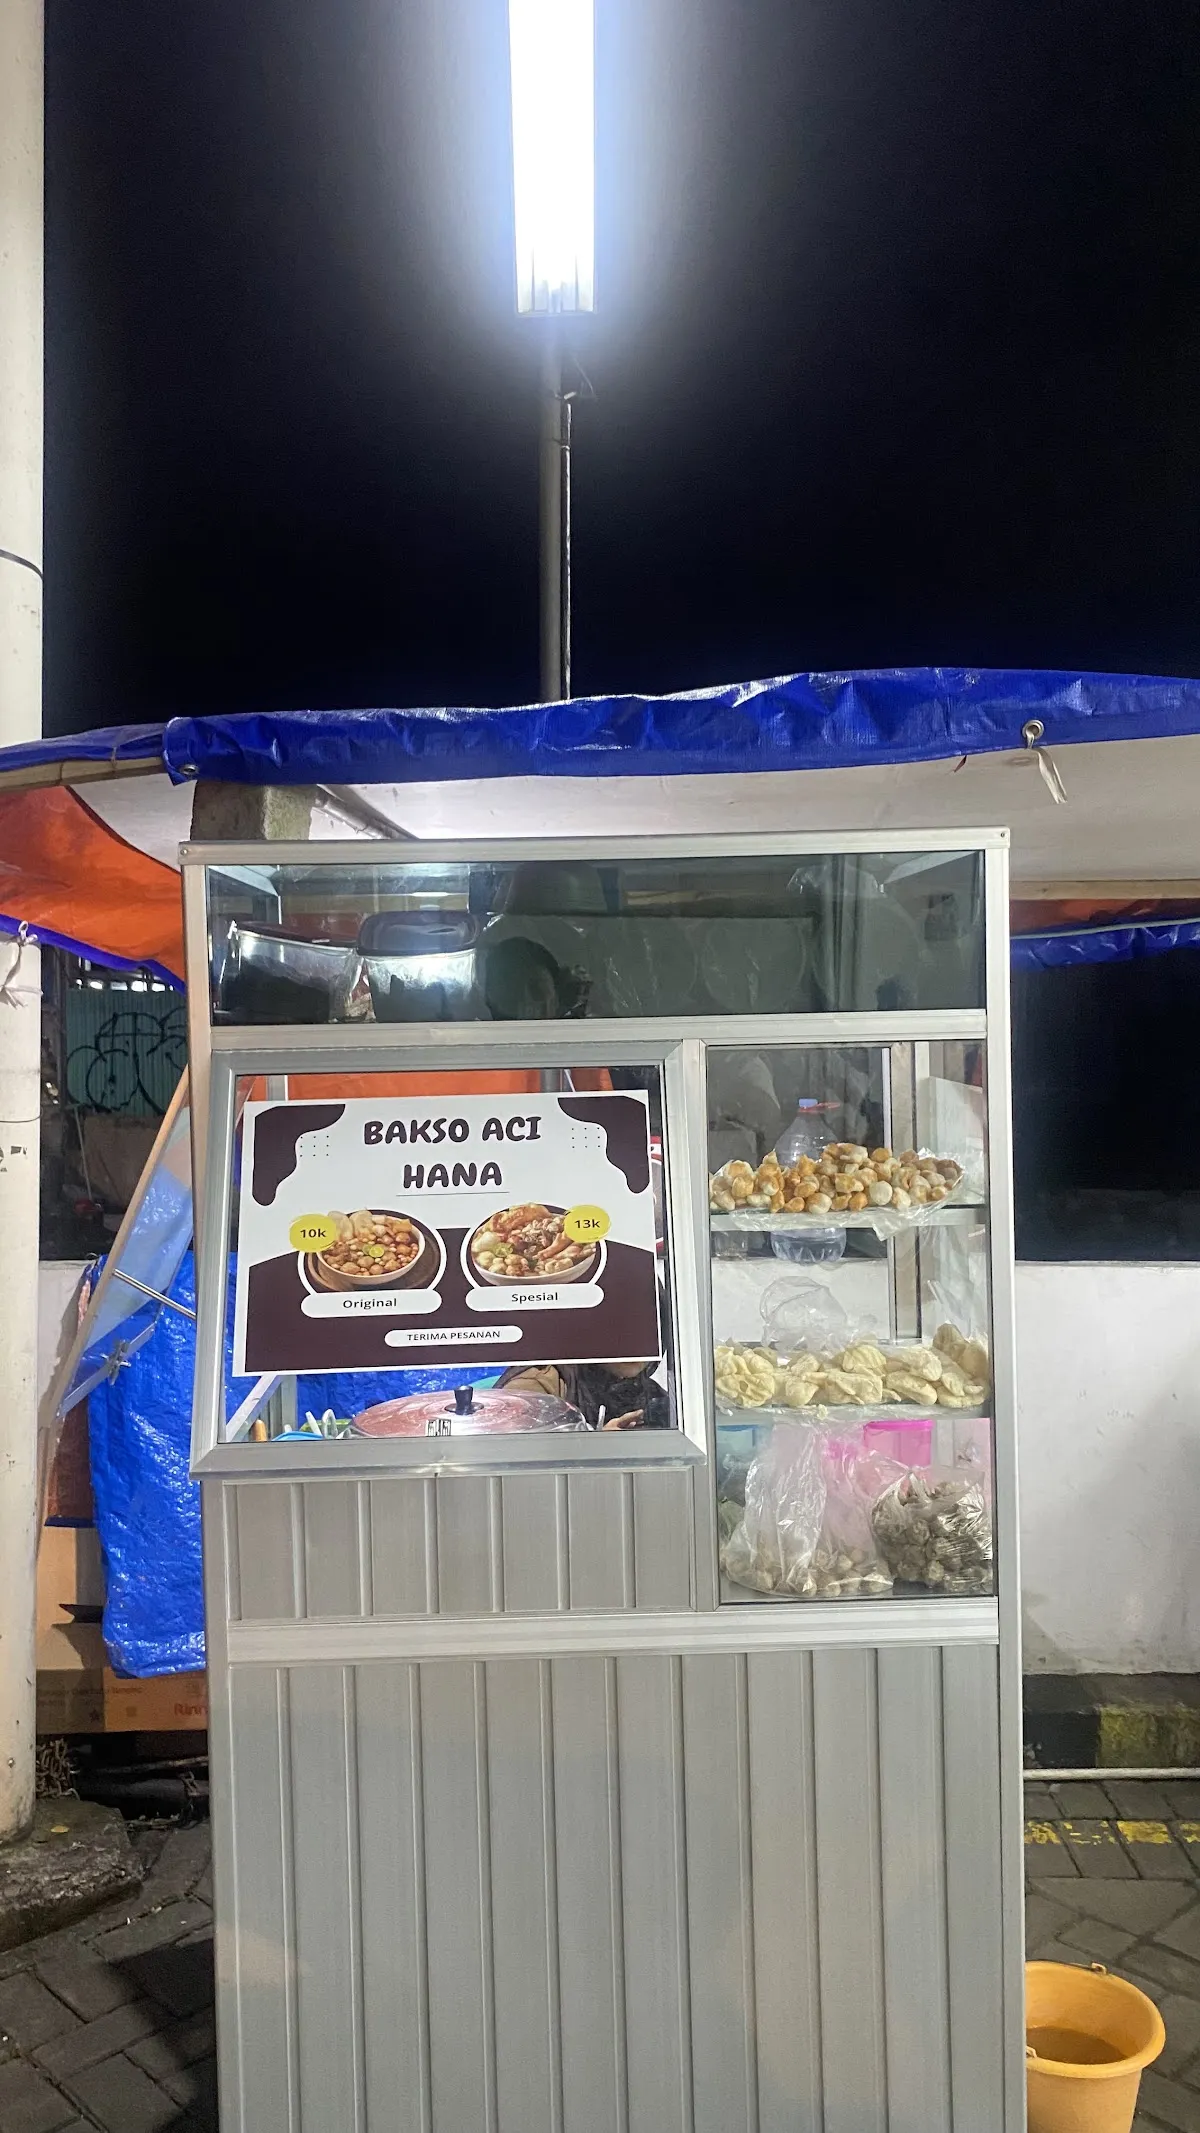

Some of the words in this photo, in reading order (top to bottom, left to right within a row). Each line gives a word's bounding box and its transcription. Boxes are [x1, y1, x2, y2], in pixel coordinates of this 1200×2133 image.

[364, 1118, 470, 1145] BAKSO
[482, 1116, 542, 1142] ACI
[403, 1162, 503, 1189] HANA
[574, 1218, 601, 1229] 13k
[300, 1228, 327, 1238] 10k
[342, 1297, 397, 1310] Original
[511, 1291, 559, 1304] Spesial
[406, 1332, 448, 1342] TERIMA
[450, 1330, 501, 1340] PESANAN
